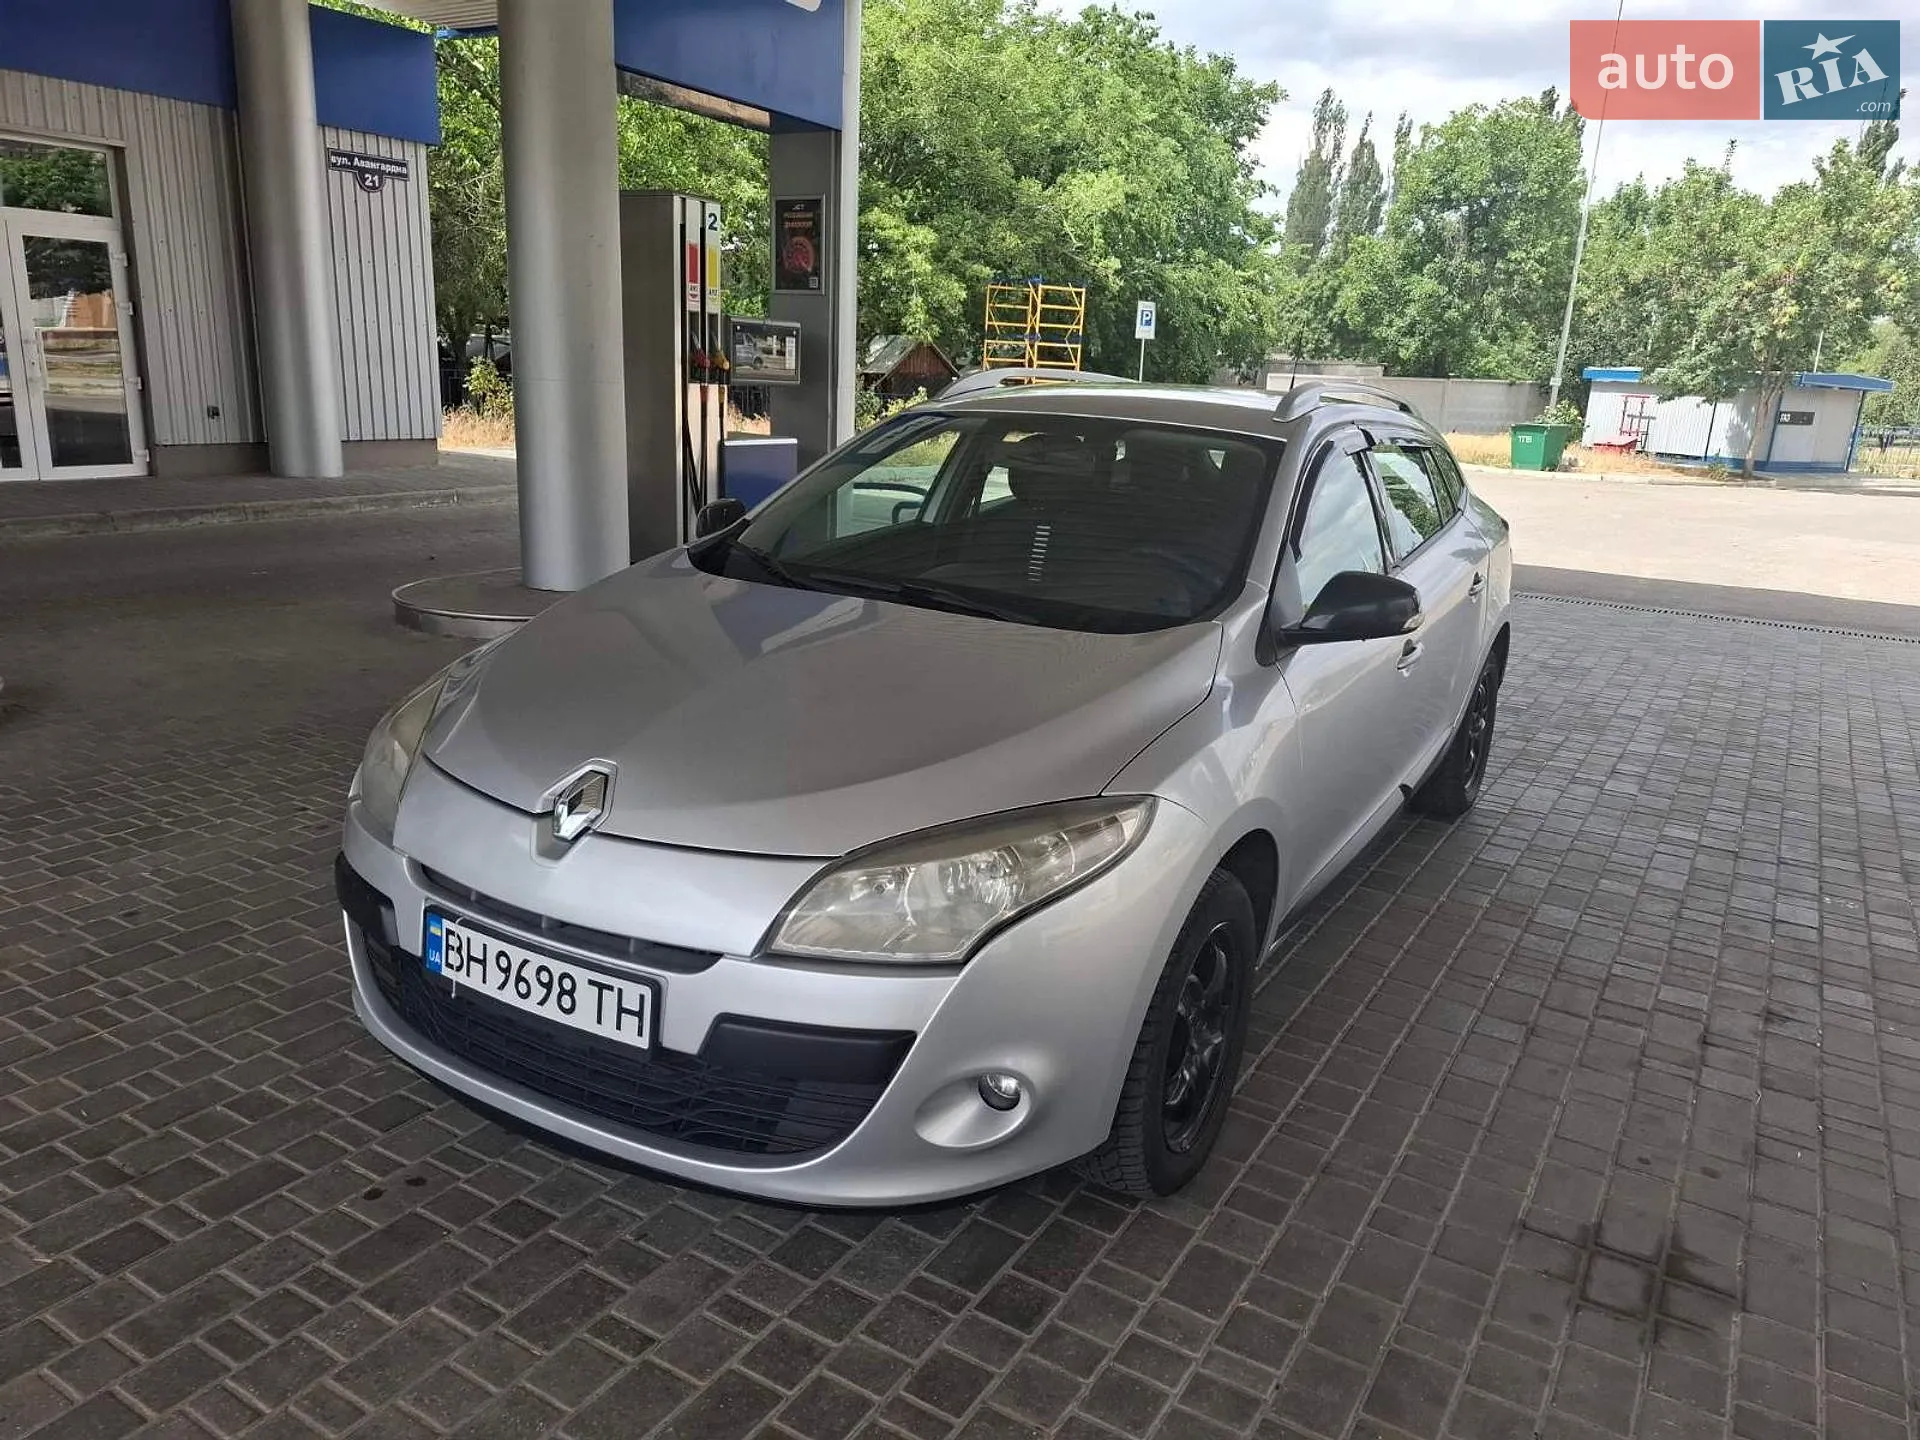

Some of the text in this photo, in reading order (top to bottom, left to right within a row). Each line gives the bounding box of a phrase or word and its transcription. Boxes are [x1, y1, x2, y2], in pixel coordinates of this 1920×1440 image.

[330, 155, 407, 174] вул. Авангардна
[364, 173, 379, 187] 21
[708, 212, 718, 231] 2
[1142, 311, 1152, 326] P
[429, 949, 441, 965] UA
[494, 949, 577, 1016] 9698
[587, 978, 646, 1038] TH
